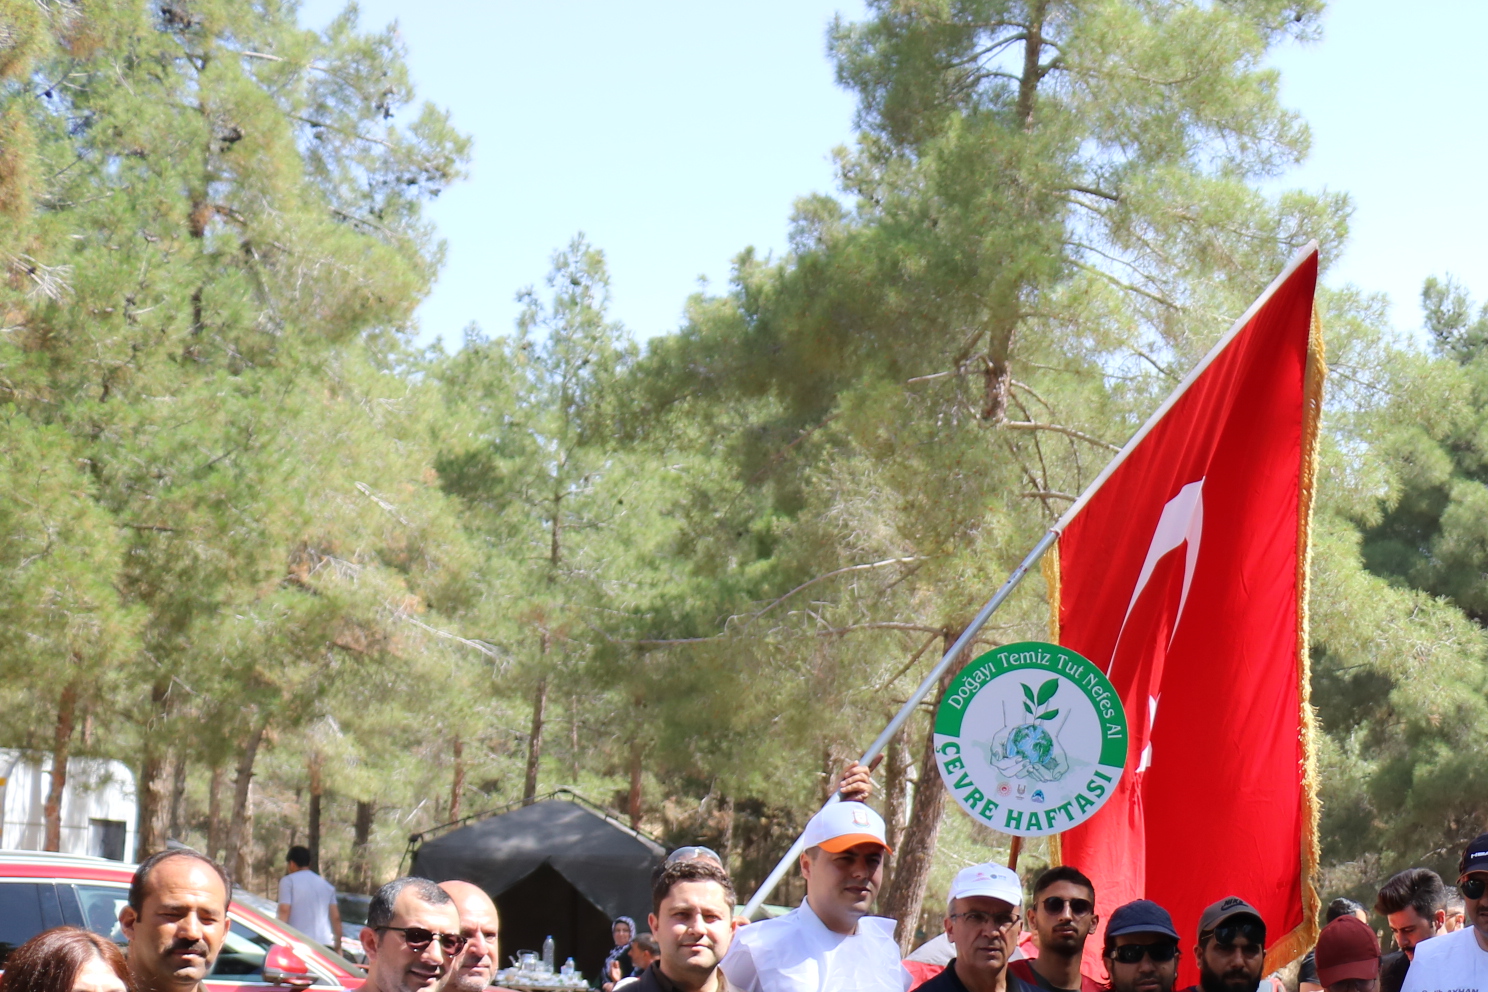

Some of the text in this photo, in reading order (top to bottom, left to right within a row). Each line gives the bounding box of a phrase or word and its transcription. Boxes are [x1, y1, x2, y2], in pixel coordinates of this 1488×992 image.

[948, 649, 1122, 739] Doğayı Temiz Tut Nefes Al
[935, 741, 1113, 831] ÇEVRE HAFTASI
